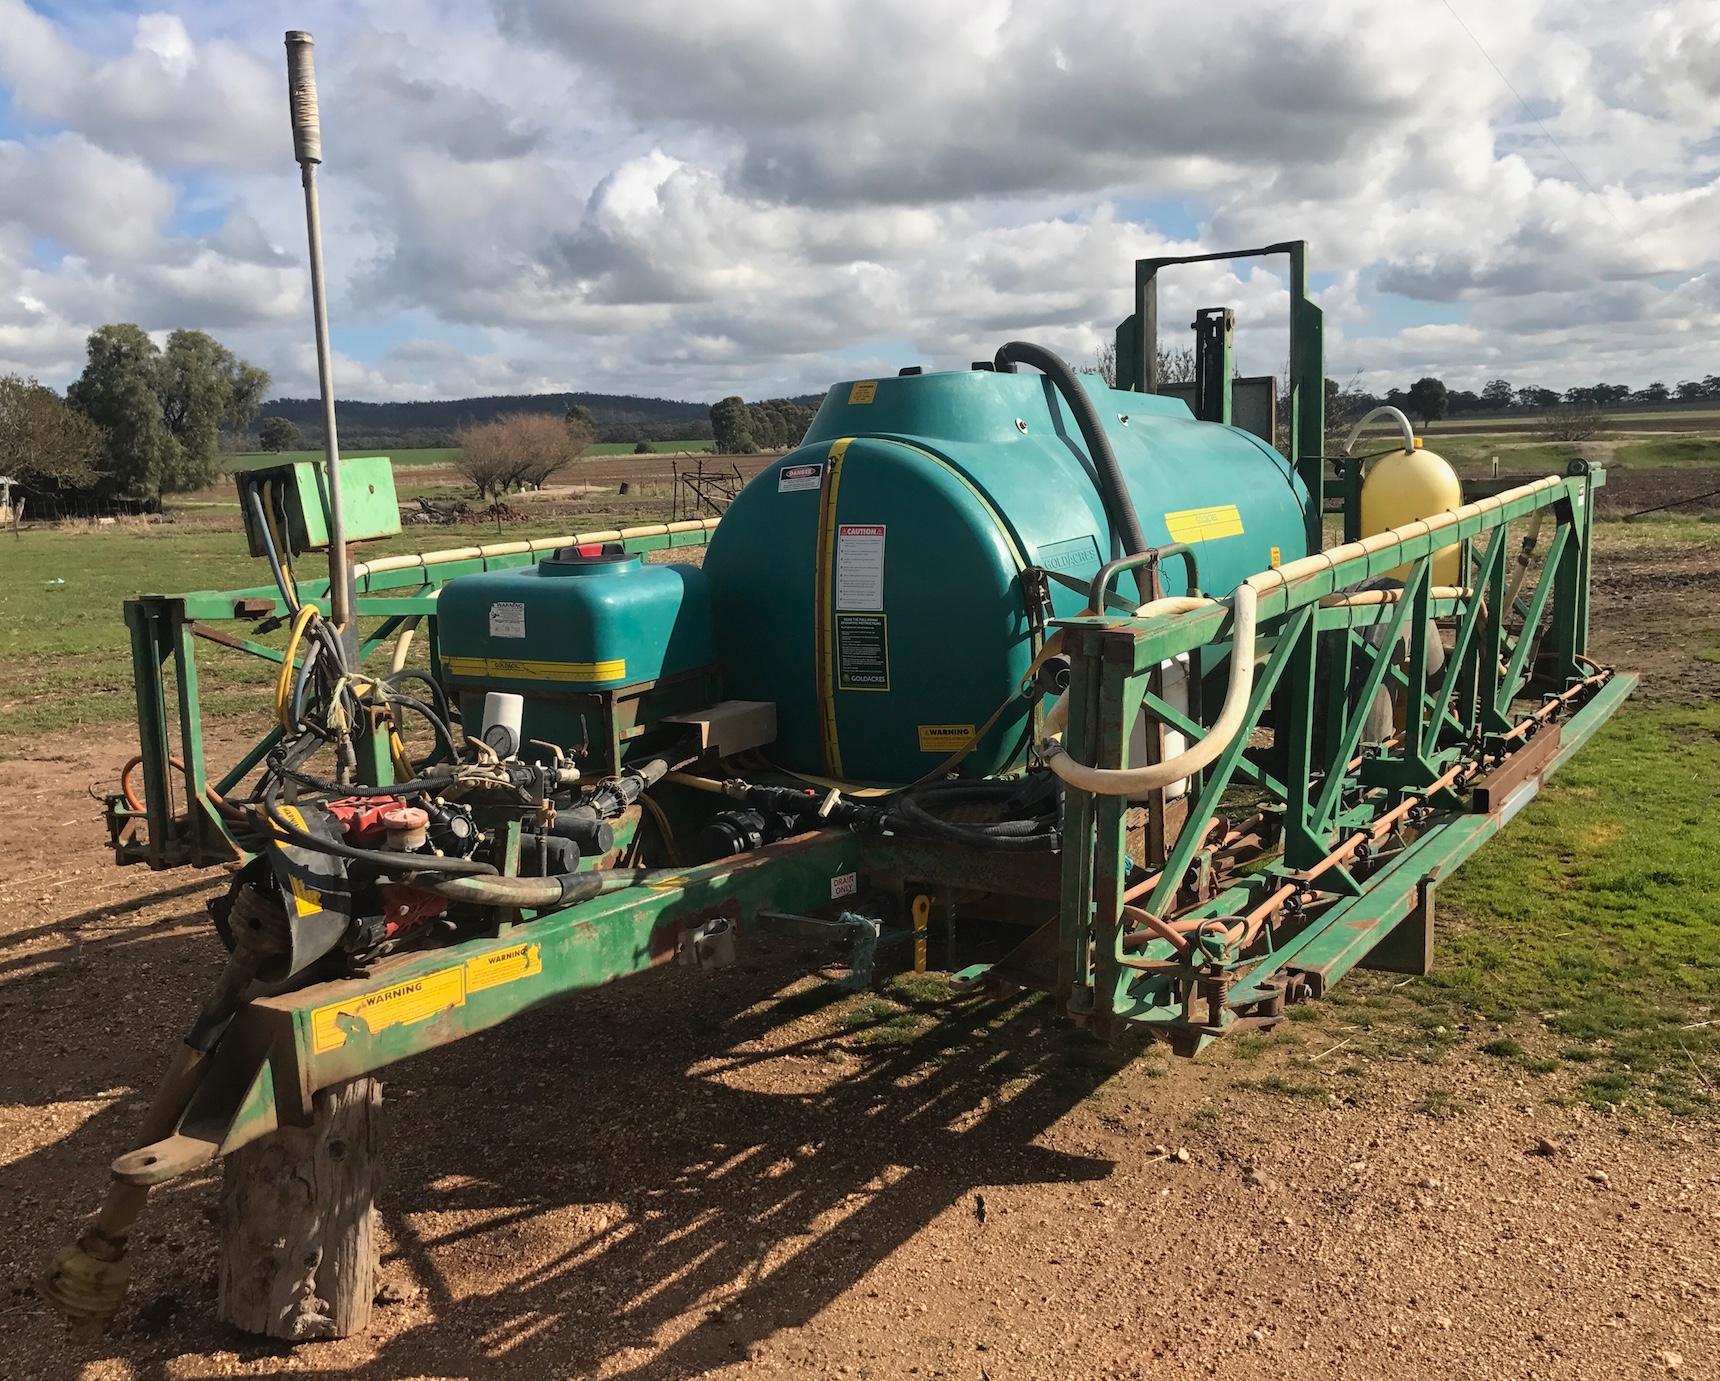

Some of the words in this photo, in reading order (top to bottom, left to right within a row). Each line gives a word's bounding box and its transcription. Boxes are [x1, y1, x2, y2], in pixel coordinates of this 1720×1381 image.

[789, 468, 812, 476] DANGER
[1044, 549, 1096, 570] GOLDACRES
[851, 675, 886, 683] GOLDACRES
[833, 875, 854, 887] DRAIN
[835, 884, 853, 895] ONLY
[488, 948, 527, 965] WARNING
[366, 982, 423, 1006] WARNING
